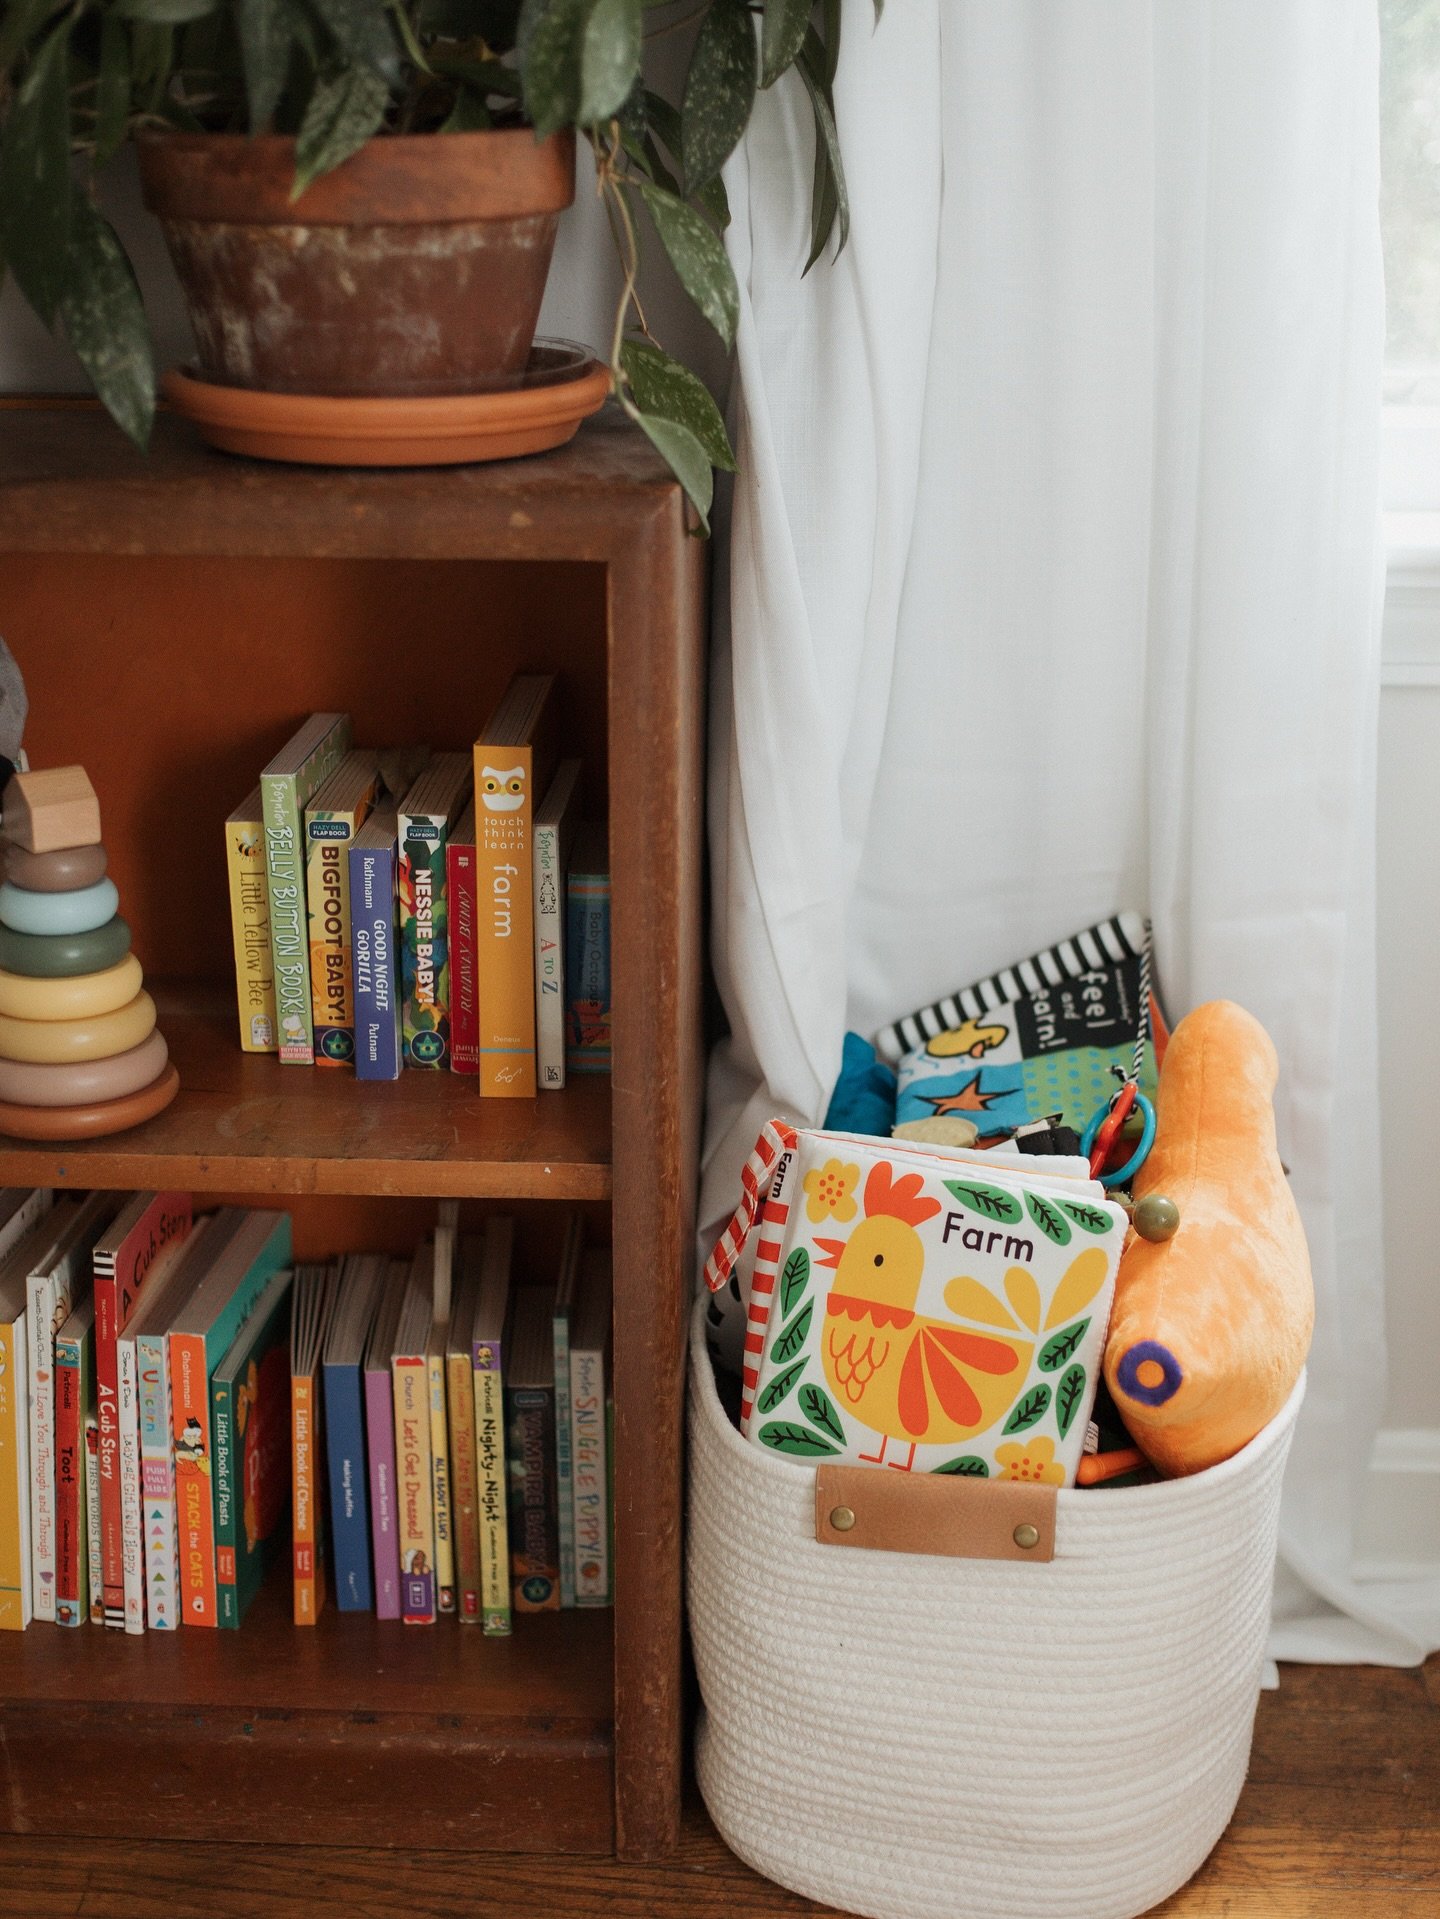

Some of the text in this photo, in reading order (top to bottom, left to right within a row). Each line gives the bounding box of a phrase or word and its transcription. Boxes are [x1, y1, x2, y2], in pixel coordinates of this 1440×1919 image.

[270, 782, 289, 826] Boynton
[484, 817, 524, 826] touch
[484, 828, 524, 837] think
[484, 840, 524, 849] learn
[537, 831, 555, 870] Boynton
[241, 871, 265, 915] Little
[363, 857, 376, 909] Rathmann
[493, 863, 518, 938] farm
[266, 826, 307, 1014] BELLY BUTTON BOOK!
[322, 847, 346, 1021] BIGFOOT BABY!
[458, 884, 473, 940] BUNNY
[244, 917, 269, 972] Yellow
[374, 920, 387, 960] GOOD
[415, 869, 435, 1004] NESSIE BABY!
[588, 912, 602, 1008] Baby Octopus
[357, 930, 371, 993] GORILLA
[460, 942, 474, 1014] RUNAWAY
[540, 938, 559, 995] A TO Z
[248, 978, 272, 1006] Bee
[1061, 992, 1082, 1019] and
[1078, 970, 1117, 1028] feel
[369, 1023, 380, 1061] Putnam
[1029, 988, 1067, 1049] earn!
[771, 1152, 793, 1199] Farm
[942, 1211, 1034, 1263] Farm
[122, 1288, 132, 1321] A
[134, 1231, 157, 1288] Cub
[64, 1371, 73, 1410] Patricelli
[142, 1370, 159, 1432] Unicorn
[182, 1350, 193, 1409] Ghahremani
[405, 1375, 415, 1410] Church
[484, 1375, 493, 1414] Patricelli
[37, 1395, 48, 1420] Love
[37, 1424, 49, 1444] You
[100, 1383, 116, 1480] A Cub Story
[404, 1419, 418, 1449] Let's
[458, 1427, 471, 1452] You
[36, 1447, 50, 1490] Through
[62, 1446, 74, 1484] Toot
[122, 1433, 136, 1482] Ladybug
[217, 1412, 231, 1526] Little Book of Pasta
[296, 1408, 309, 1531] Little Book of Cheese
[405, 1453, 420, 1476] Get
[436, 1457, 445, 1473] ALL
[480, 1418, 500, 1522] Nighty-Night
[524, 1411, 543, 1505] VAMPIRE
[576, 1397, 603, 1558] SNUGGLE PUPPY!
[38, 1495, 50, 1513] and
[124, 1483, 136, 1505] Girl
[437, 1476, 446, 1508] ABOUT
[37, 1515, 52, 1560] Through
[90, 1460, 103, 1589] FIRST WORDS Clothes
[186, 1482, 204, 1589] STACK the CATS
[124, 1536, 138, 1576] Happy
